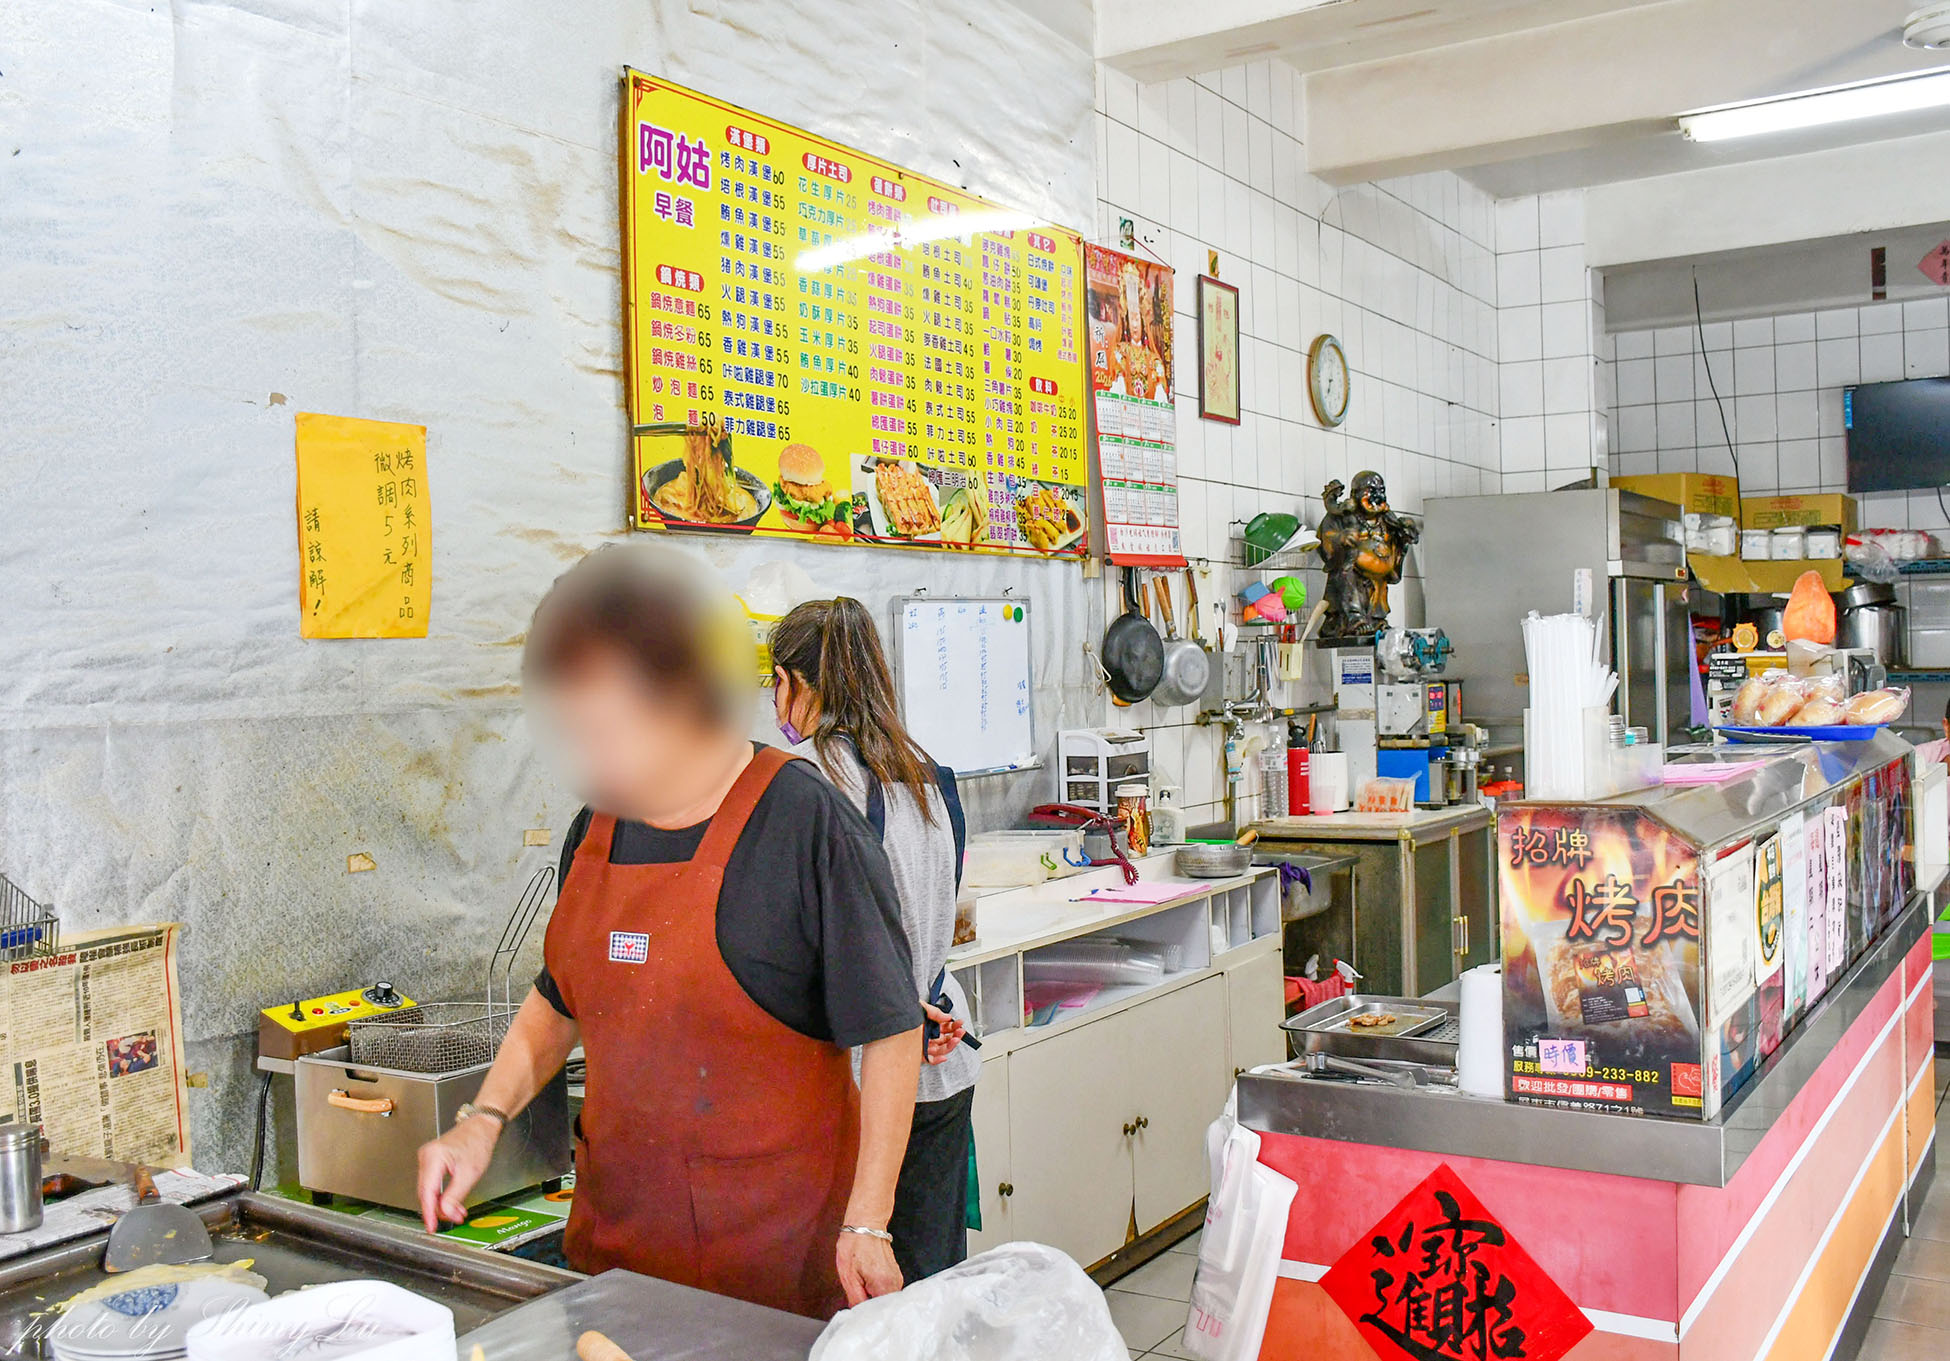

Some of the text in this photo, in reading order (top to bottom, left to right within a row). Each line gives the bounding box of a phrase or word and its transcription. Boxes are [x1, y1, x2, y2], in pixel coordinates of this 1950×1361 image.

[729, 127, 766, 155] 漢堡類
[640, 123, 710, 189] 阿姑
[721, 151, 785, 186] 烤肉漢堡 60
[807, 154, 848, 183] 厚片土司
[721, 178, 785, 210] 培根漢堡 55
[798, 176, 844, 205] 花生厚片
[655, 192, 693, 227] 早餐
[798, 202, 844, 229] 巧克力厚片
[721, 203, 785, 236] 鮪魚漢堡 55
[774, 245, 785, 260] 55
[773, 271, 785, 287] 55
[963, 278, 972, 290] 40
[721, 283, 785, 312] 火腿漢堡 55
[698, 303, 711, 320] 65
[904, 306, 914, 320] 35
[964, 300, 973, 314] 35
[799, 302, 858, 330] 奶酥厚片 35
[1012, 315, 1021, 328] 35
[722, 310, 788, 339] 熱狗漢堡 55
[869, 319, 915, 343] 起司蛋餅 35
[964, 322, 973, 335] 35
[698, 331, 711, 347] 65
[800, 327, 858, 354] 玉米厚片 35
[1013, 334, 1021, 347] 30
[723, 337, 789, 364] 香雞漢堡 55
[870, 343, 915, 366] 火腿蛋餅 35
[963, 343, 974, 358] 45
[1013, 351, 1022, 363] 30
[700, 359, 713, 374] 65
[800, 352, 859, 379] 鮪魚厚片 40
[965, 366, 974, 380] 35
[777, 374, 788, 389] 70
[1014, 368, 1022, 381] 20
[801, 378, 860, 402] 沙拉蛋厚片 40
[906, 376, 916, 390] 35
[700, 386, 714, 401] 65
[966, 388, 975, 401] 35
[1014, 387, 1022, 400] 35
[724, 390, 790, 416] 泰式雞腿堡 65
[907, 399, 917, 413] 45
[1014, 403, 1022, 416] 30
[702, 411, 715, 427] 50
[925, 401, 975, 424] 泰式土司 55
[1059, 406, 1067, 418] 25
[1069, 407, 1077, 420] 20
[724, 417, 790, 441] 菲力雞腿堡 65
[907, 422, 917, 436] 55
[926, 424, 976, 445] 菲力土司 55
[1015, 421, 1024, 434] 20
[1059, 425, 1067, 438] 25
[1069, 426, 1077, 439] 20
[908, 445, 918, 458] 60
[1016, 439, 1024, 452] 20
[1060, 446, 1068, 459] 20
[1070, 448, 1077, 460] 15
[968, 455, 976, 468] 60
[1016, 457, 1025, 469] 45
[968, 477, 978, 490] 60
[374, 451, 398, 565] 微調5元
[396, 448, 418, 619] 烤肉系列商品
[1511, 826, 1592, 867] 招牌
[1568, 874, 1700, 946] 烤肉
[1594, 966, 1636, 987] 烤肉
[1543, 1043, 1579, 1066] 時價
[497, 1219, 532, 1235] Mango
